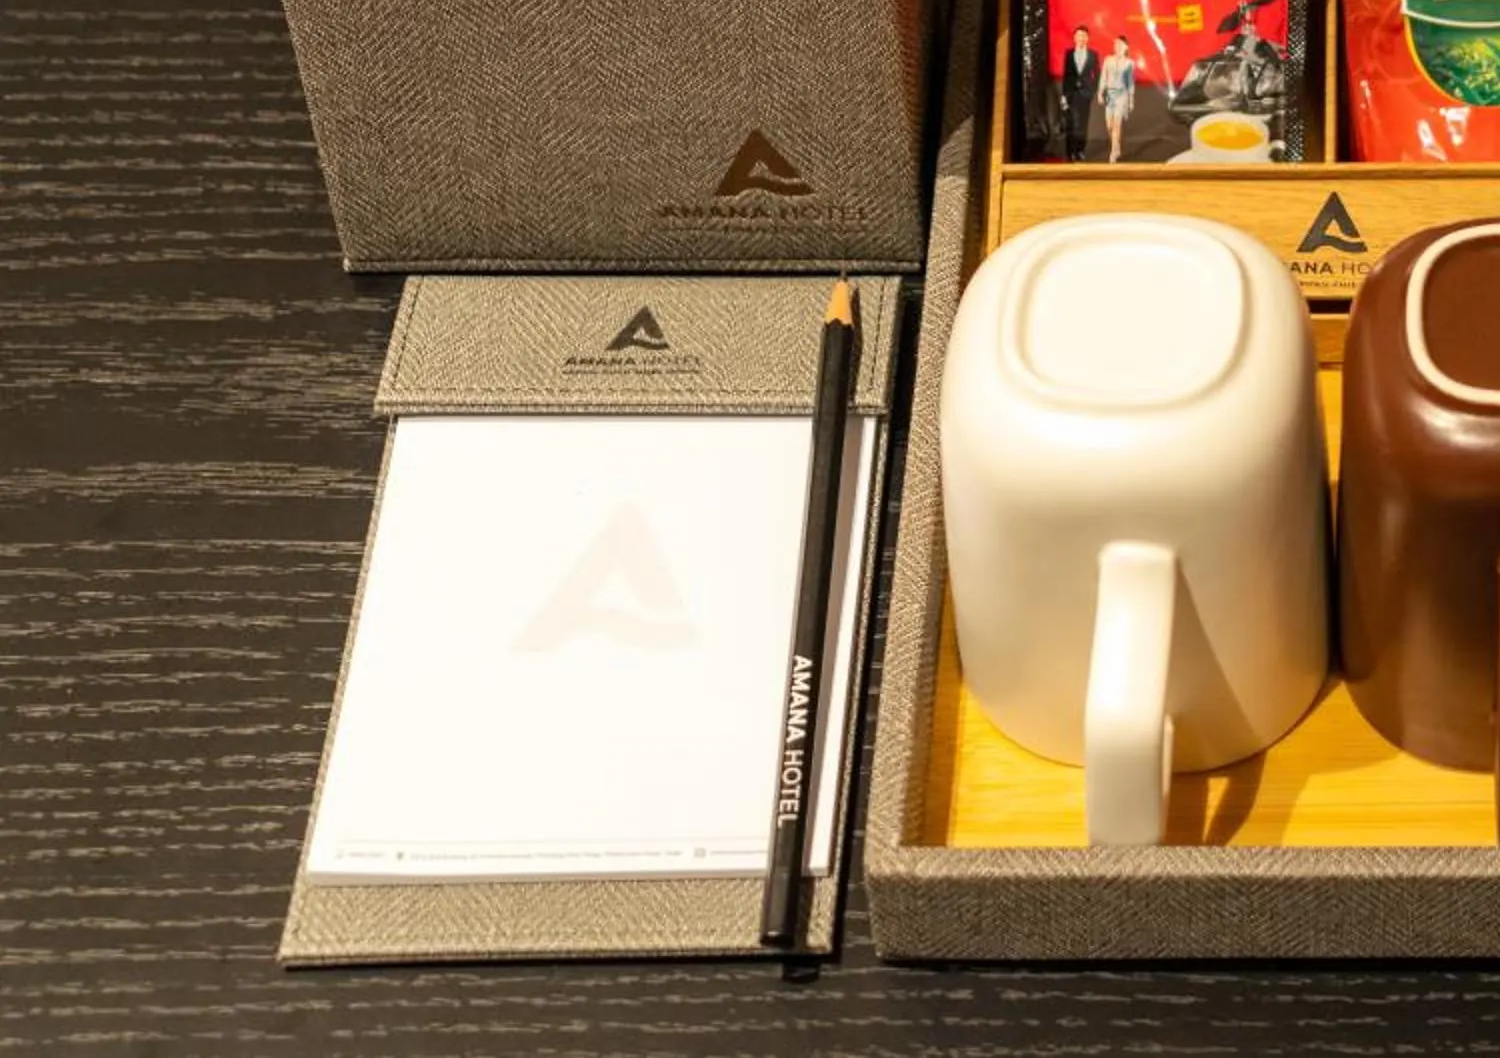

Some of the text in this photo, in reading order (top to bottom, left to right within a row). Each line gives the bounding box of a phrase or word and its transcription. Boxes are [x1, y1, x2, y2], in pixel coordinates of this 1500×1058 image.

[1290, 261, 1334, 275] ANA
[776, 654, 814, 830] AMANA HOTEL
